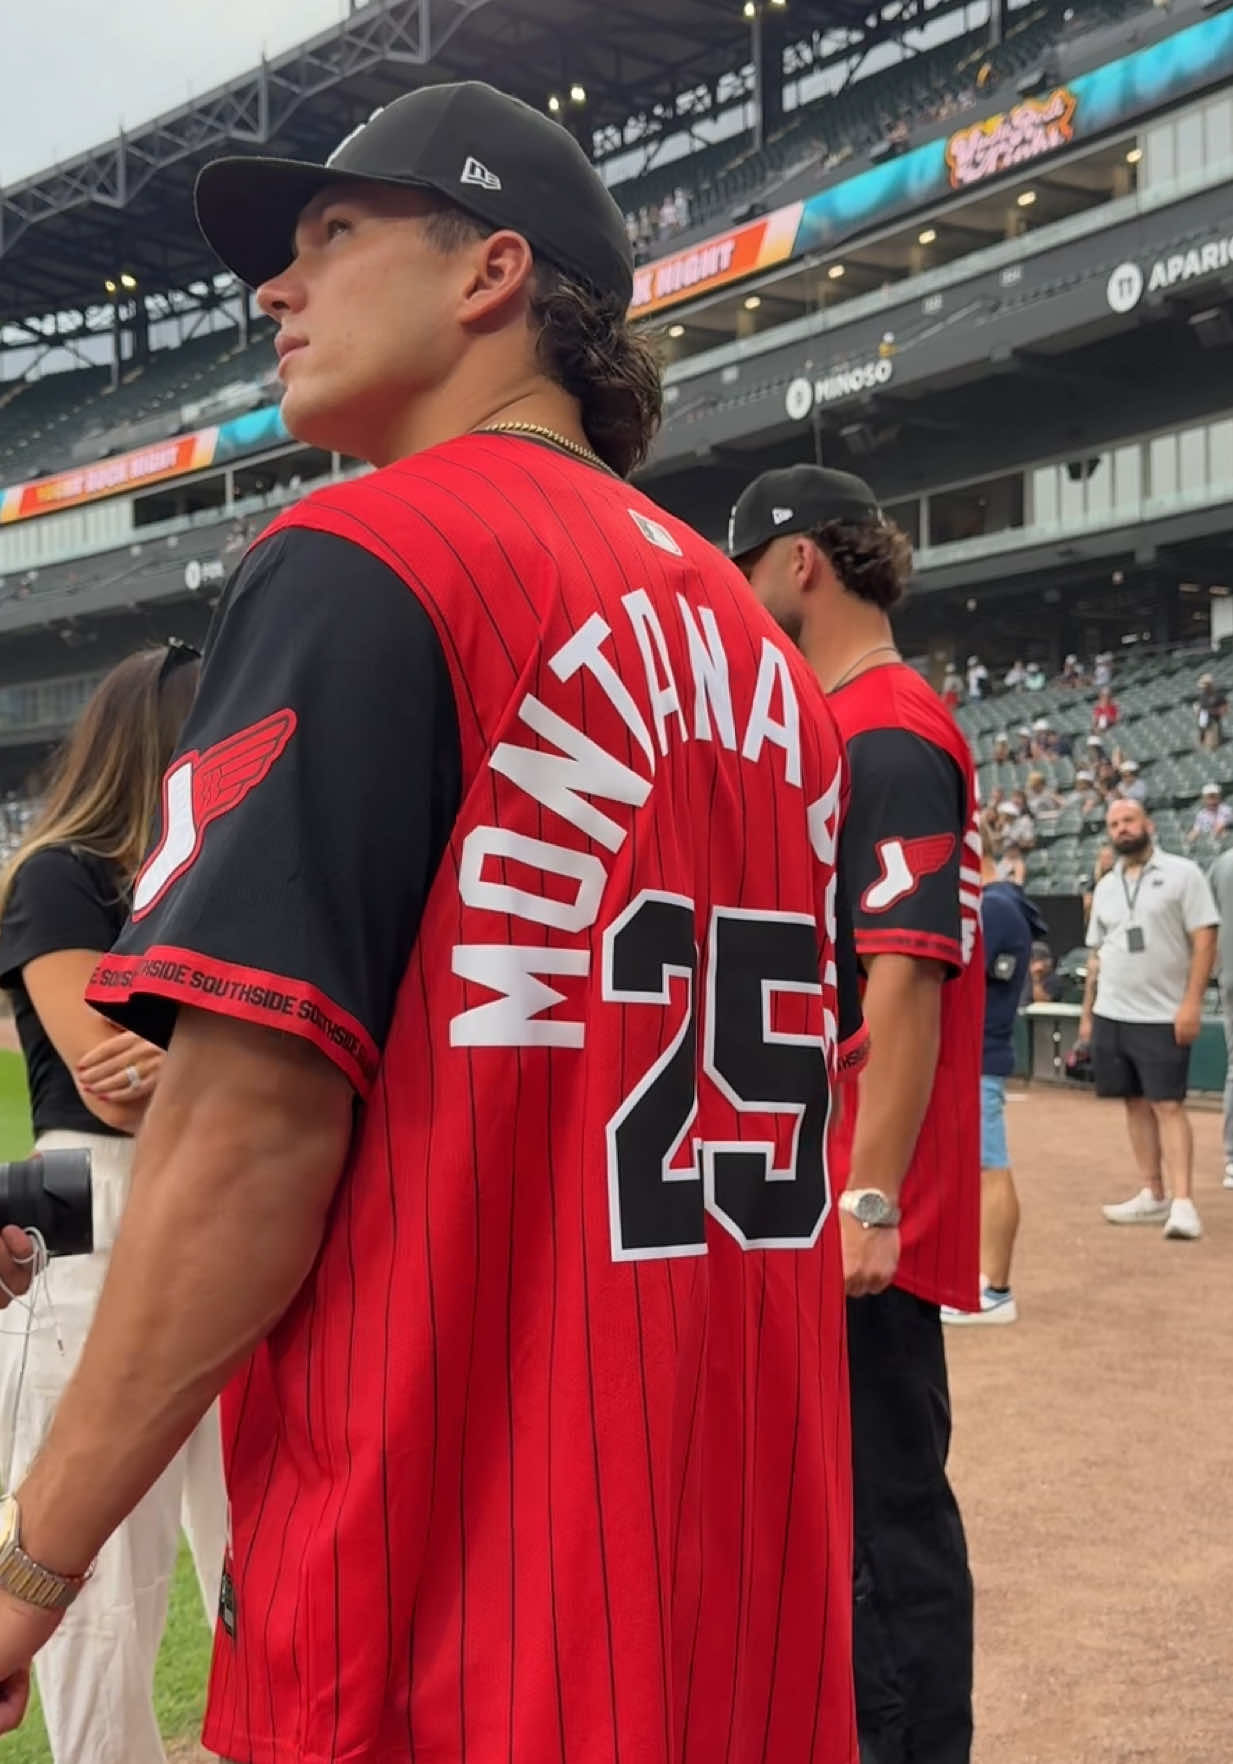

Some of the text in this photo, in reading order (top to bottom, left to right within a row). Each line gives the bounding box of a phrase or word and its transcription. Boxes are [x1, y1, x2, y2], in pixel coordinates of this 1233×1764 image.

[189, 970, 298, 1017] SOUTHSIDE
[450, 588, 801, 1048] MONTANA
[602, 889, 832, 1262] 25
